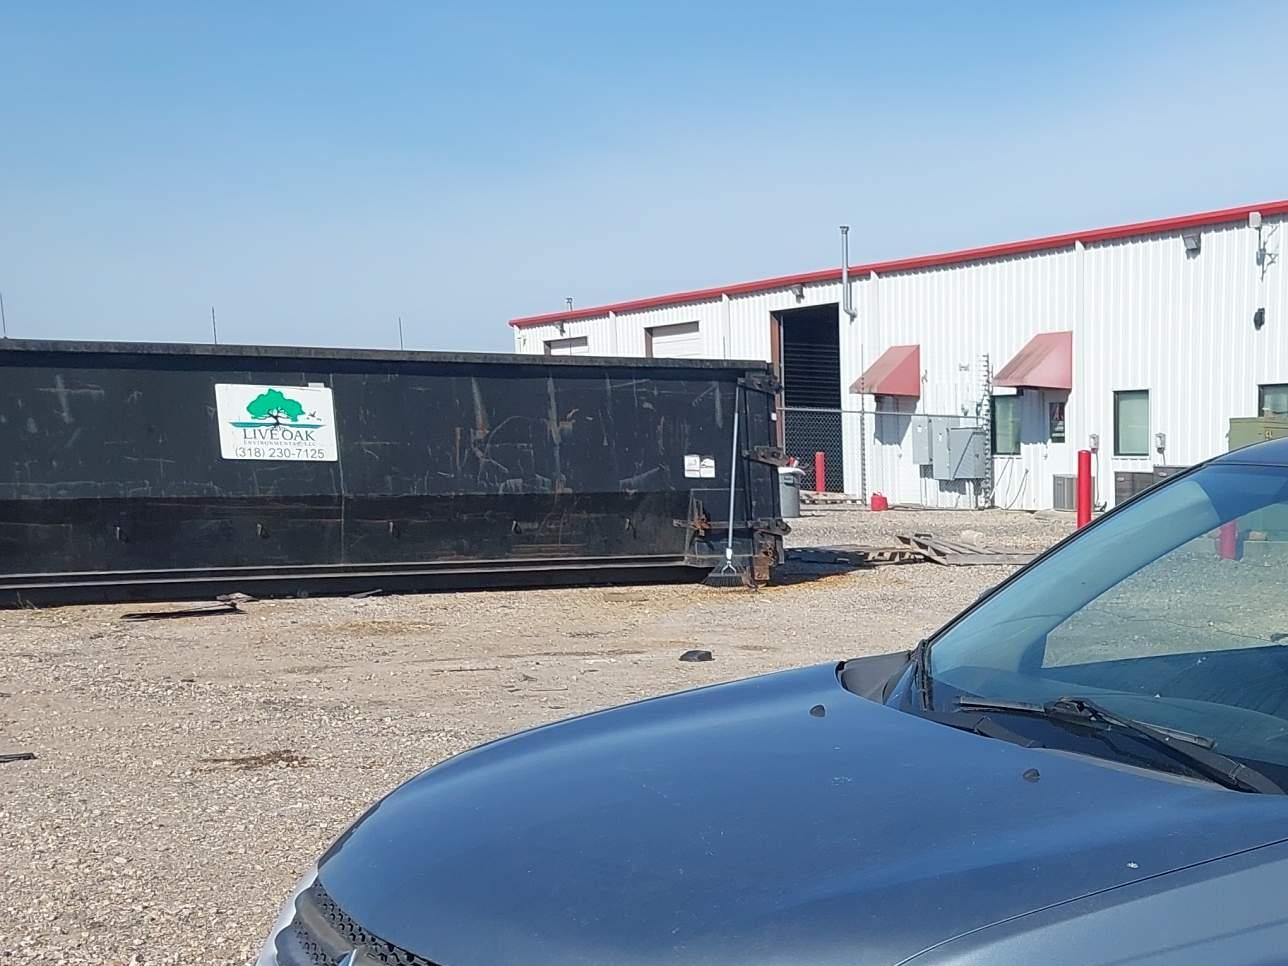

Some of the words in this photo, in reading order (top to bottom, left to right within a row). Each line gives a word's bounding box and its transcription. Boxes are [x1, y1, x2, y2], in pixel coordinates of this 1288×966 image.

[243, 428, 280, 440] LIVE
[281, 429, 316, 441] OAK
[235, 447, 265, 458] (318)
[269, 447, 325, 459] 230-7125
